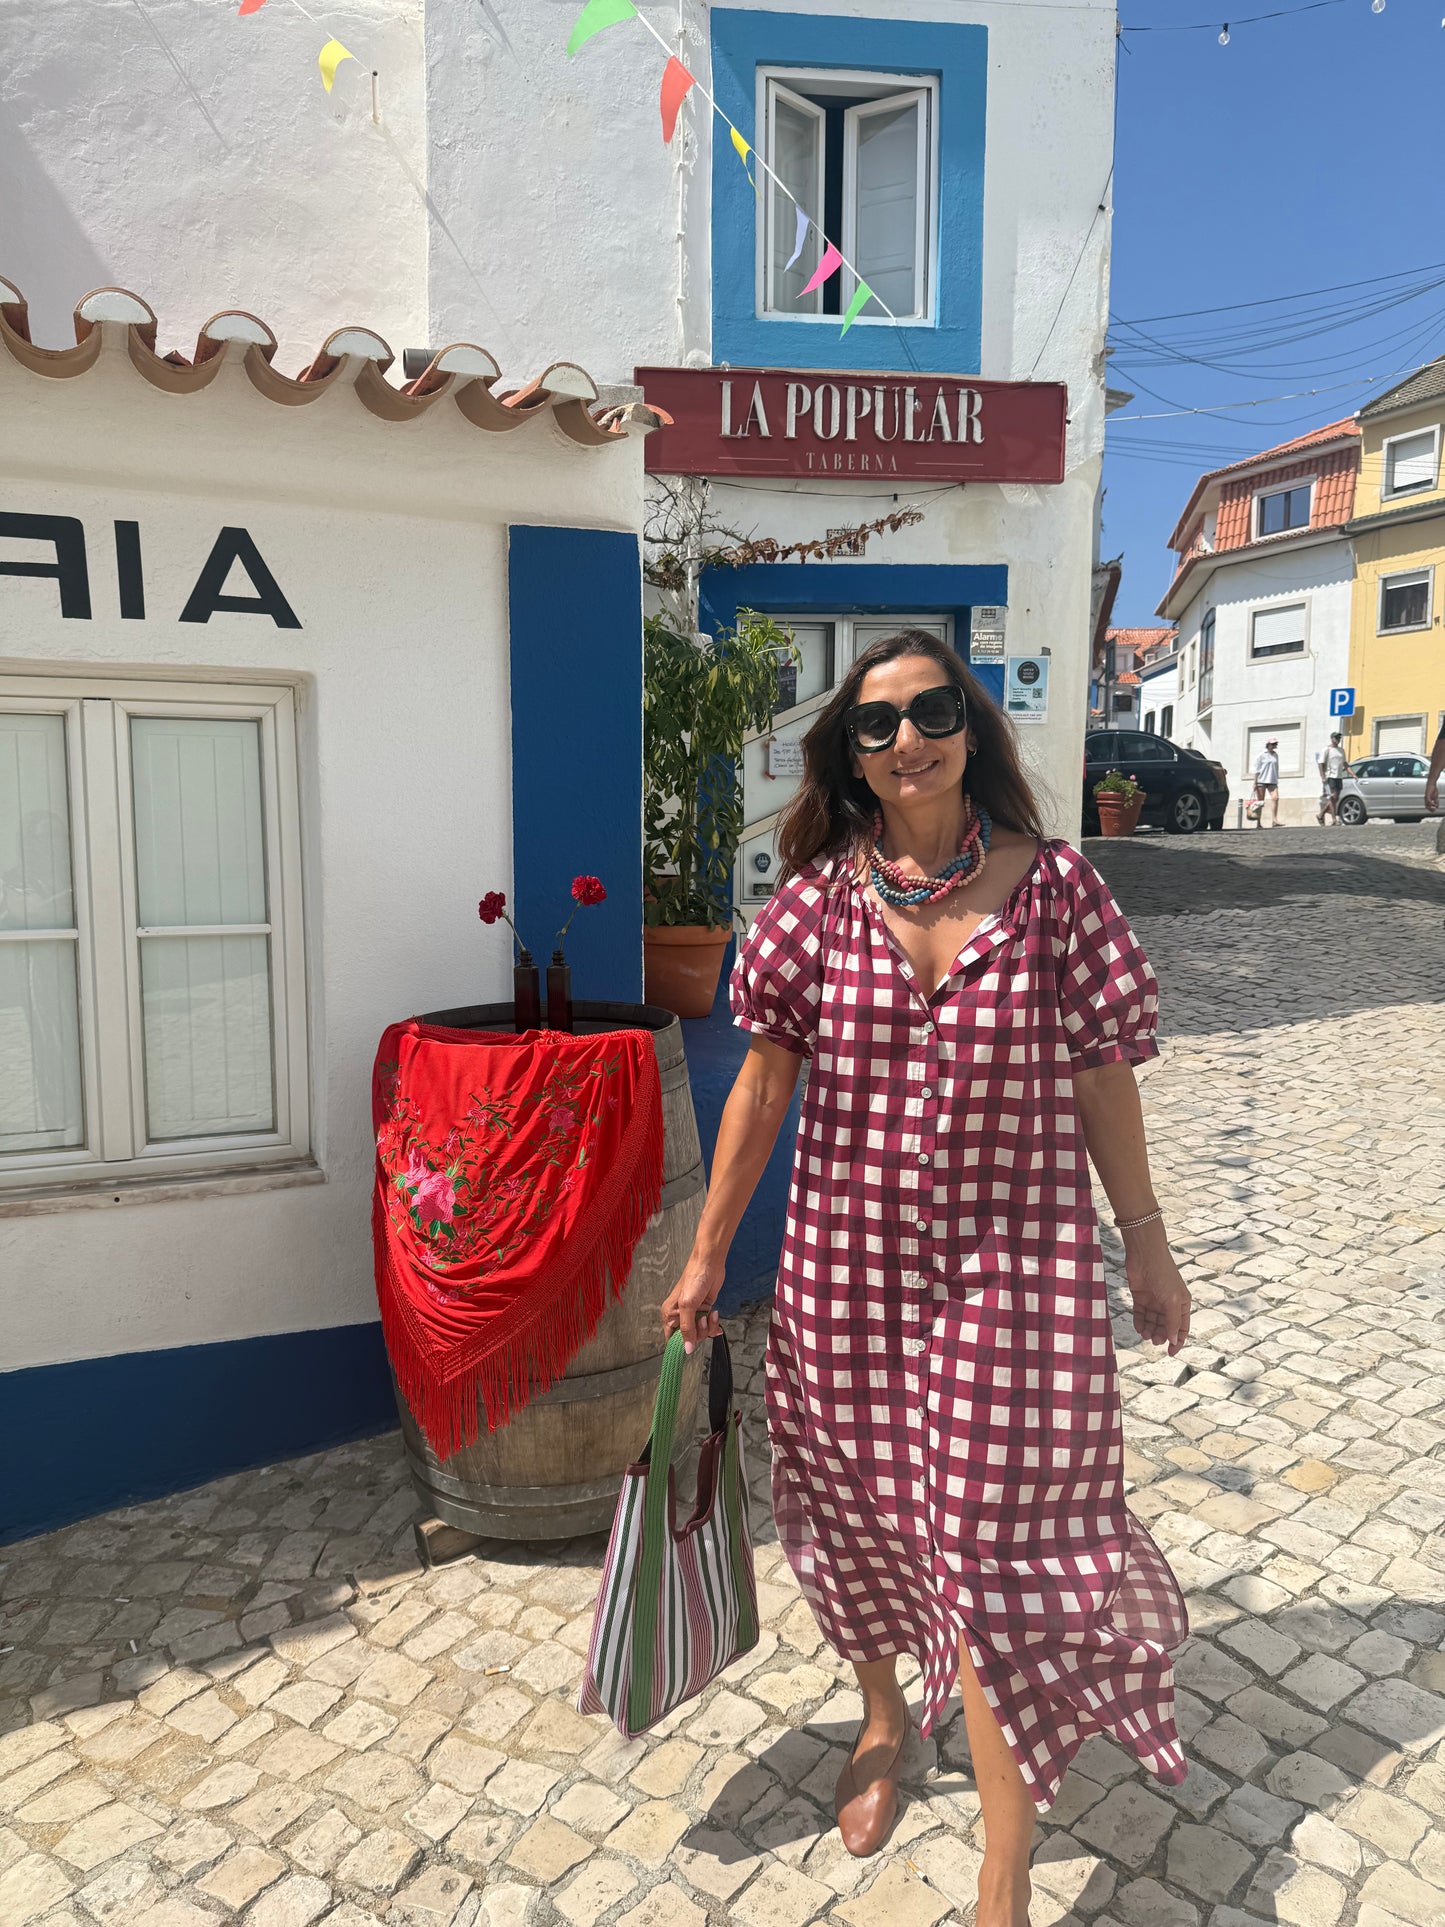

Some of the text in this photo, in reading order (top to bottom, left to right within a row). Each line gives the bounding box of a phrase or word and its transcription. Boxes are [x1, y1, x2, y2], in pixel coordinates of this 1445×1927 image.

[719, 379, 985, 445] LA POPULAR
[806, 451, 898, 472] TABERNA
[973, 632, 1003, 641] Alarme
[1334, 690, 1350, 714] P
